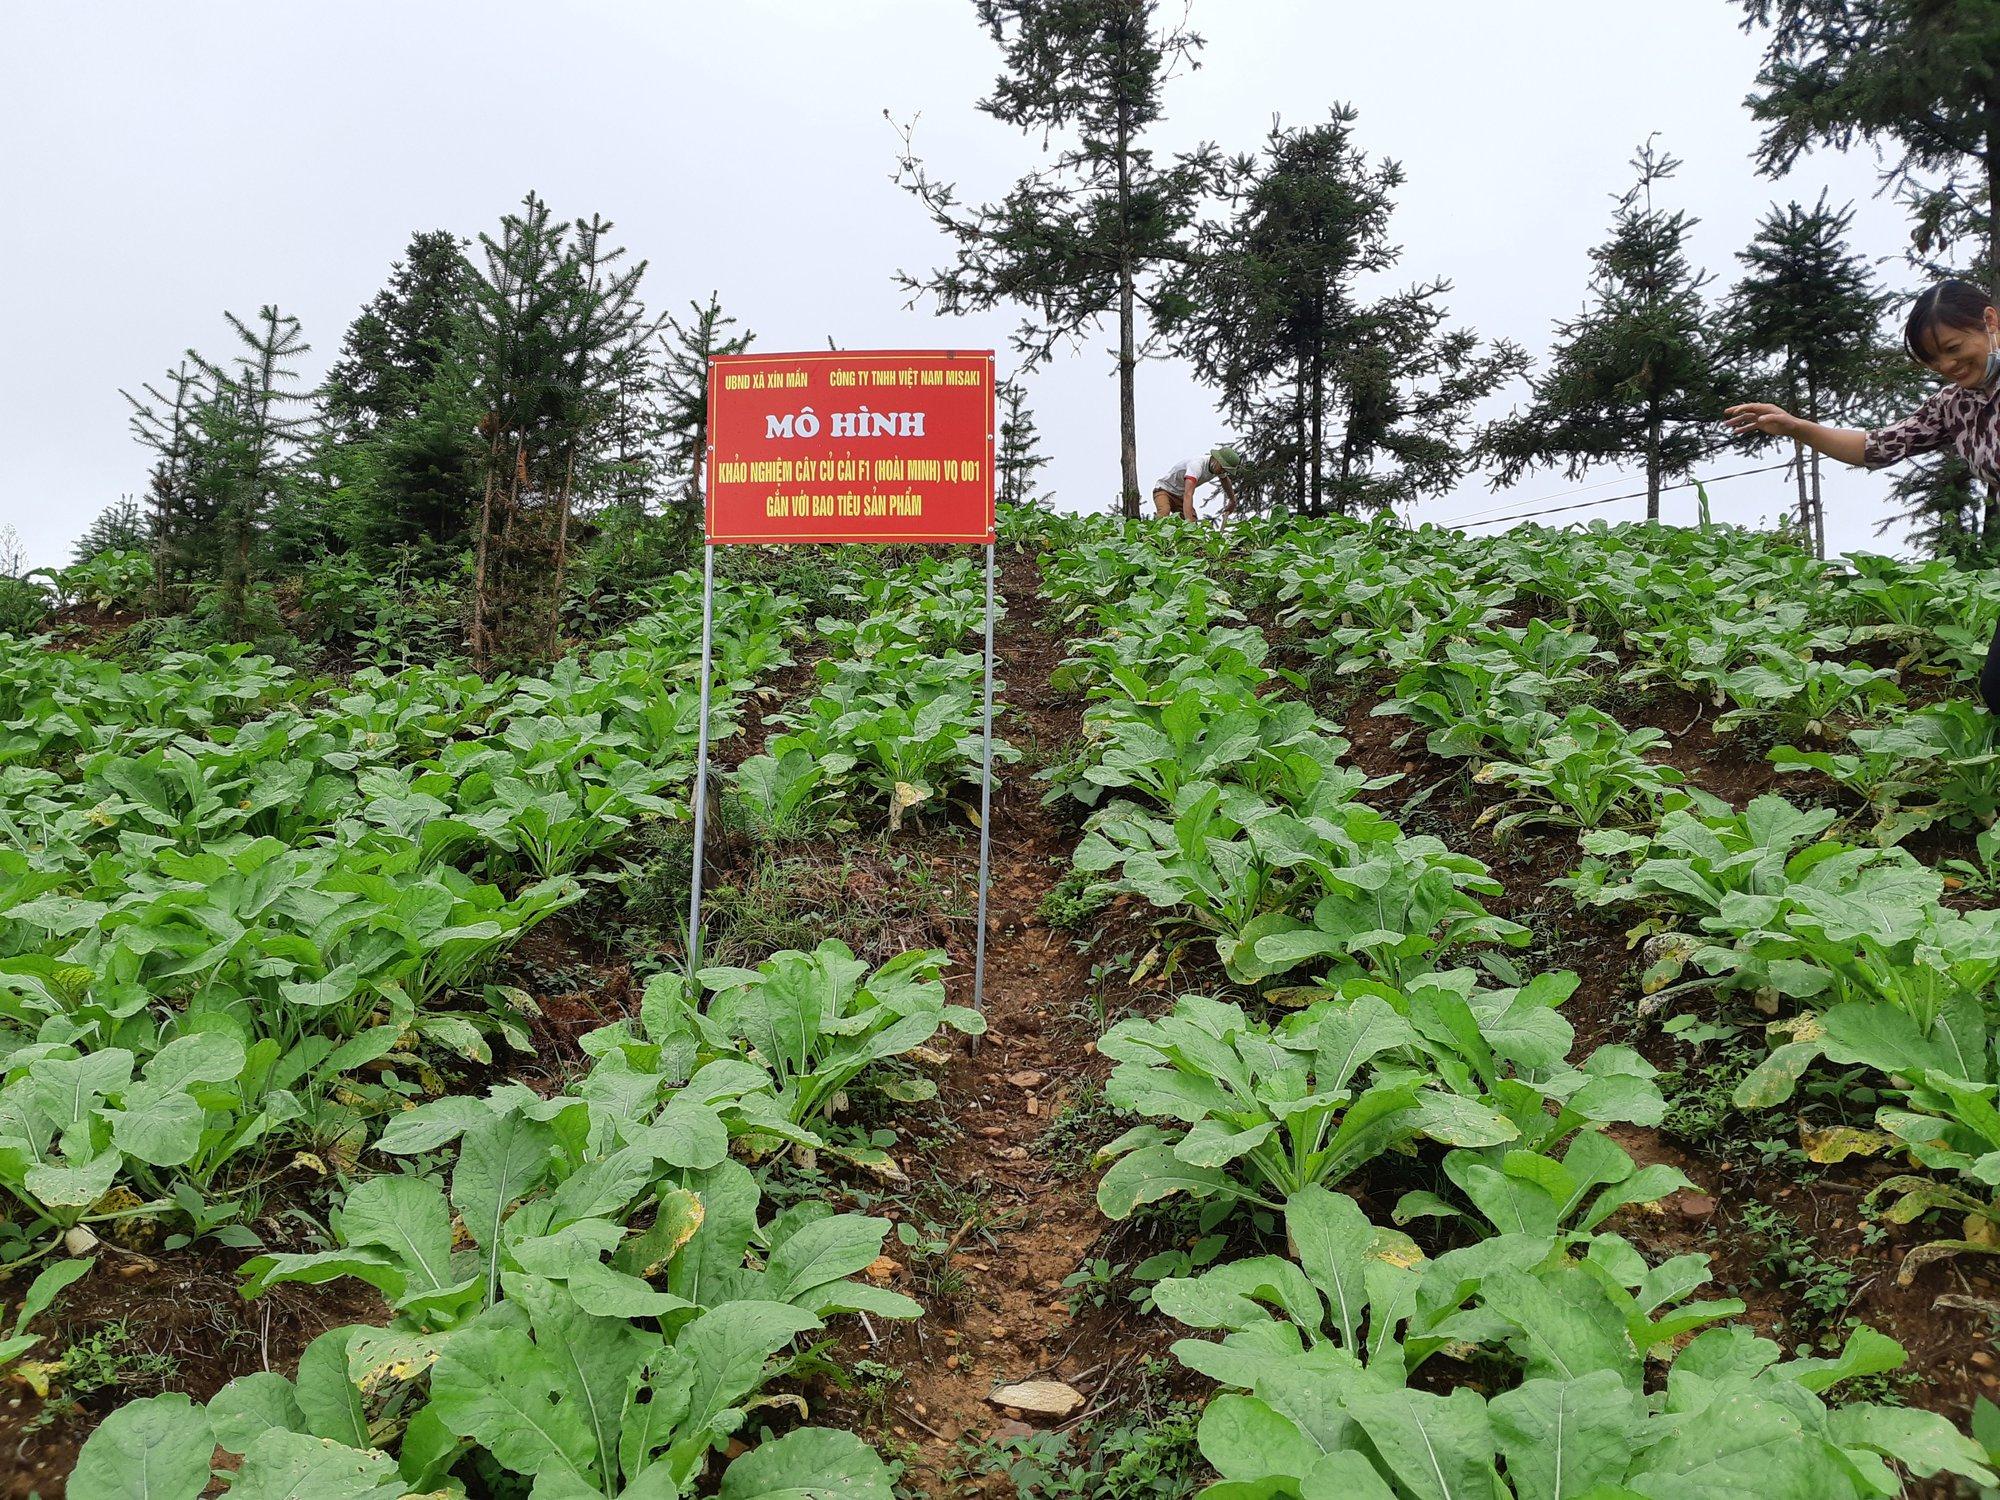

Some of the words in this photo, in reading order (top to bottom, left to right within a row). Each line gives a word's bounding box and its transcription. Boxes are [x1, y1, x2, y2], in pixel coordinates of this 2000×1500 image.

[725, 375, 750, 390] UBND
[752, 371, 765, 389] XÃ
[829, 368, 856, 387] CÔNG
[858, 371, 869, 386] TY
[871, 370, 896, 386] TNHH
[898, 367, 919, 389] VIỆT
[921, 370, 943, 386] NAM
[945, 370, 980, 386] MISAKI
[765, 406, 820, 439] MÔ
[830, 405, 925, 437] HÌNH
[718, 453, 747, 483] KHẢO
[750, 456, 792, 487] NGHIỆM
[795, 456, 817, 482] CÂY
[819, 451, 834, 482] CỦ
[837, 450, 856, 482] CẢI
[858, 460, 870, 481] F1
[874, 455, 904, 483] (HOÀI
[907, 459, 941, 483] MINH)
[943, 460, 958, 483] VQ
[961, 460, 980, 482] 001
[766, 488, 789, 517] GẮN
[791, 489, 810, 517] VỚI
[812, 495, 834, 517] BAO
[837, 490, 861, 516] TIÊU
[863, 486, 886, 516] SẢN
[889, 486, 922, 516] PHẨM
